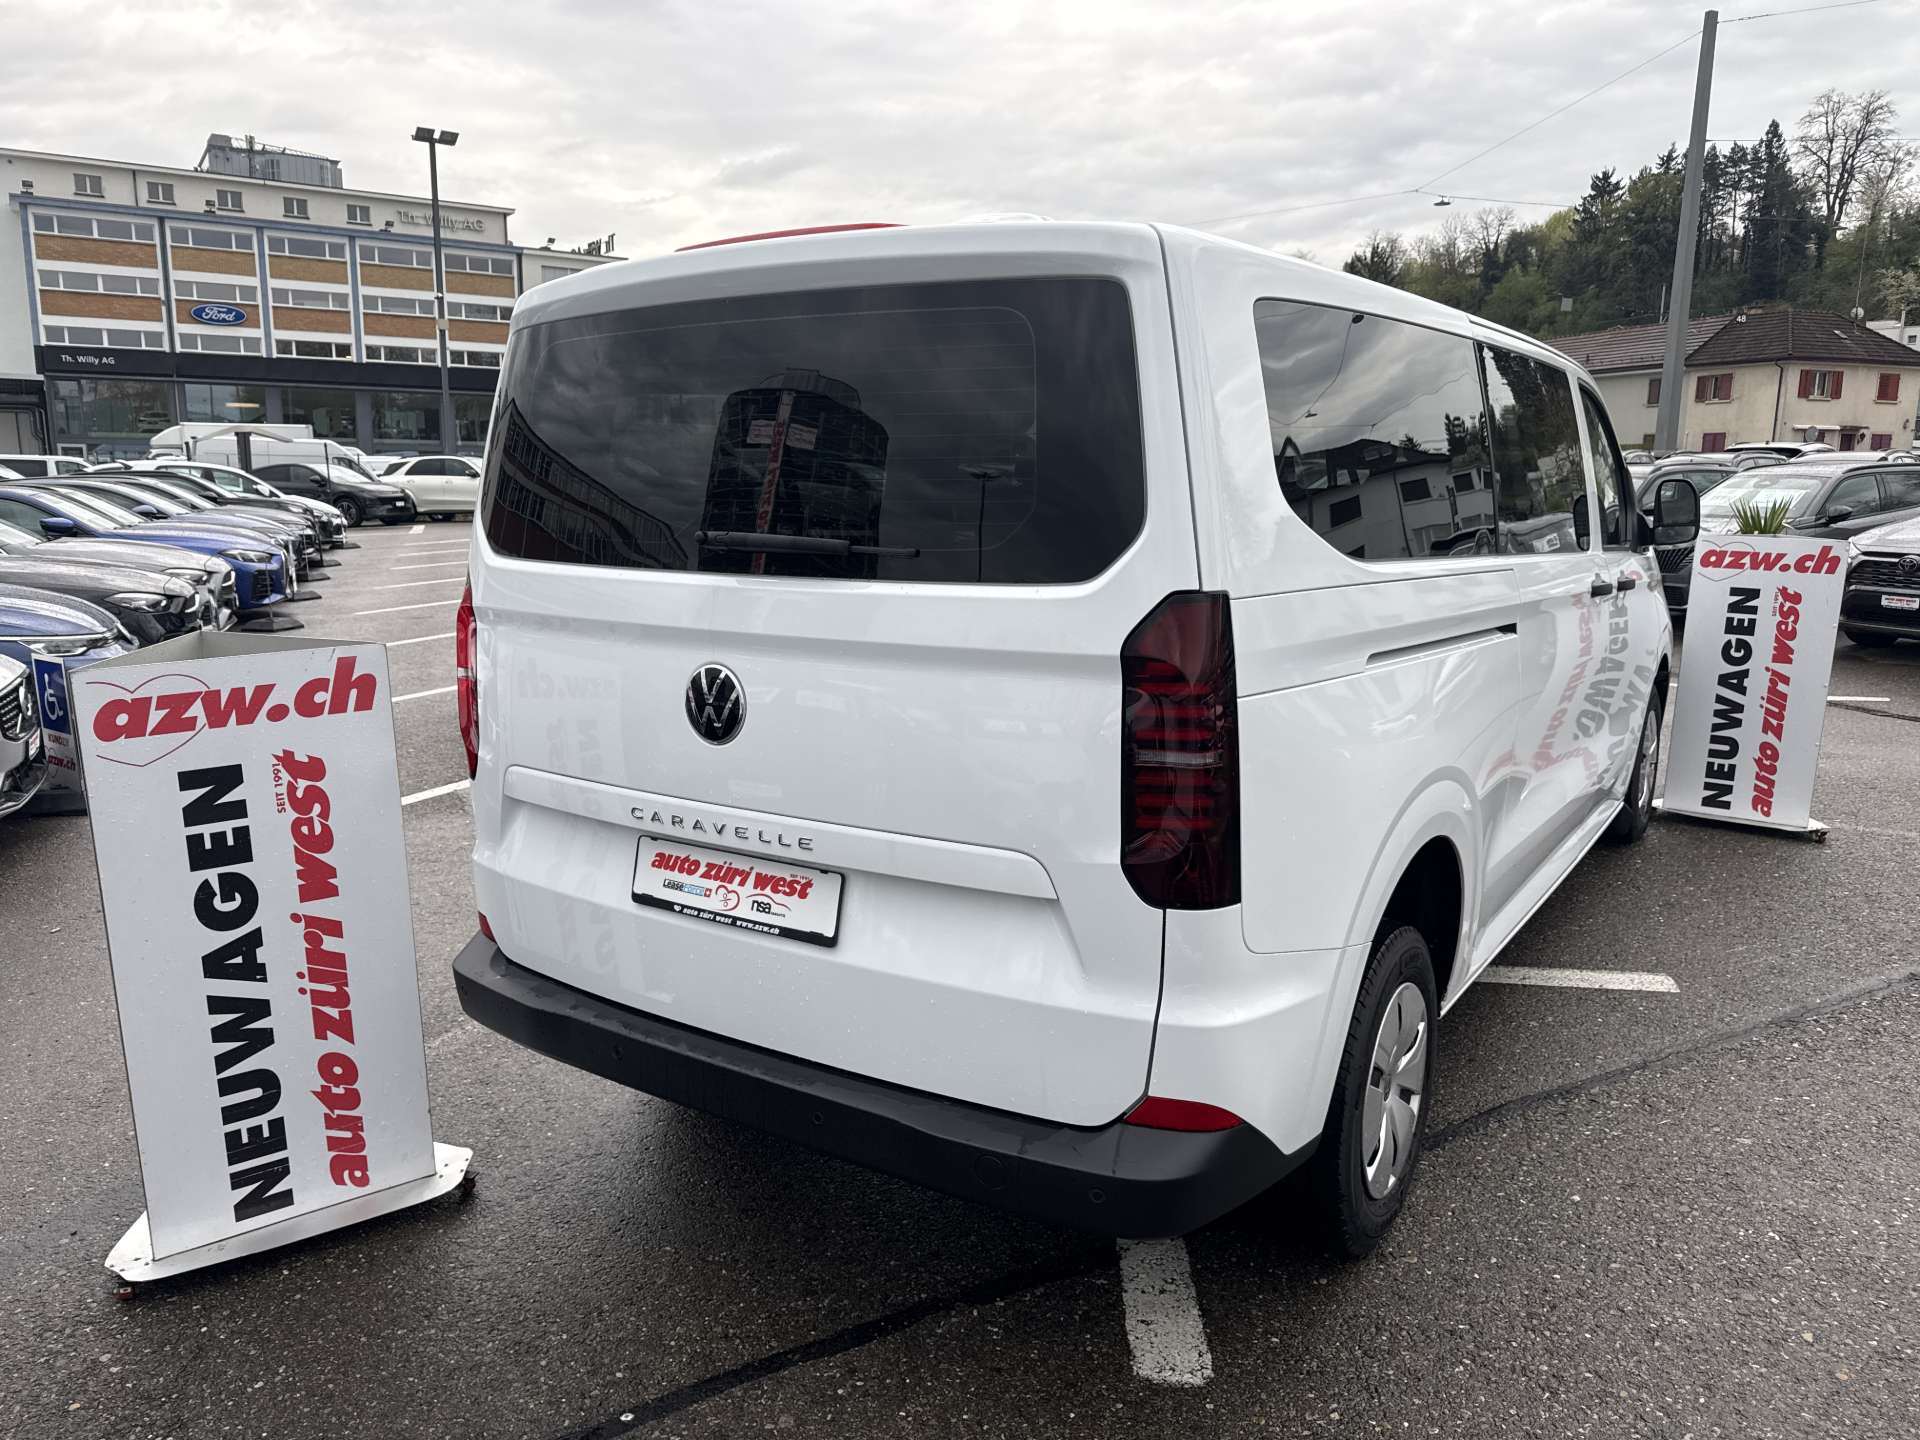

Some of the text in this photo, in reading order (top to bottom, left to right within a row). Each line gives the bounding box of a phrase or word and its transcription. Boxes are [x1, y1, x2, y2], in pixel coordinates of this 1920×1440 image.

[463, 215, 487, 232] AG
[201, 306, 237, 322] Ford
[60, 354, 116, 366] Th. Willy AG
[1699, 545, 1841, 575] azw.ch
[92, 656, 377, 742] azw.ch
[1700, 587, 1761, 810] NEUWAGEN
[1751, 586, 1802, 817] auto züri west
[272, 763, 287, 814] SEIT 1991
[631, 807, 814, 851] CARAVELLE
[651, 852, 815, 899] auto züri west
[682, 907, 780, 935] auto züri west www.azw.ch
[751, 900, 771, 914] nsa
[271, 748, 370, 1188] auto züri west
[177, 763, 295, 1222] NEUWAGEN
